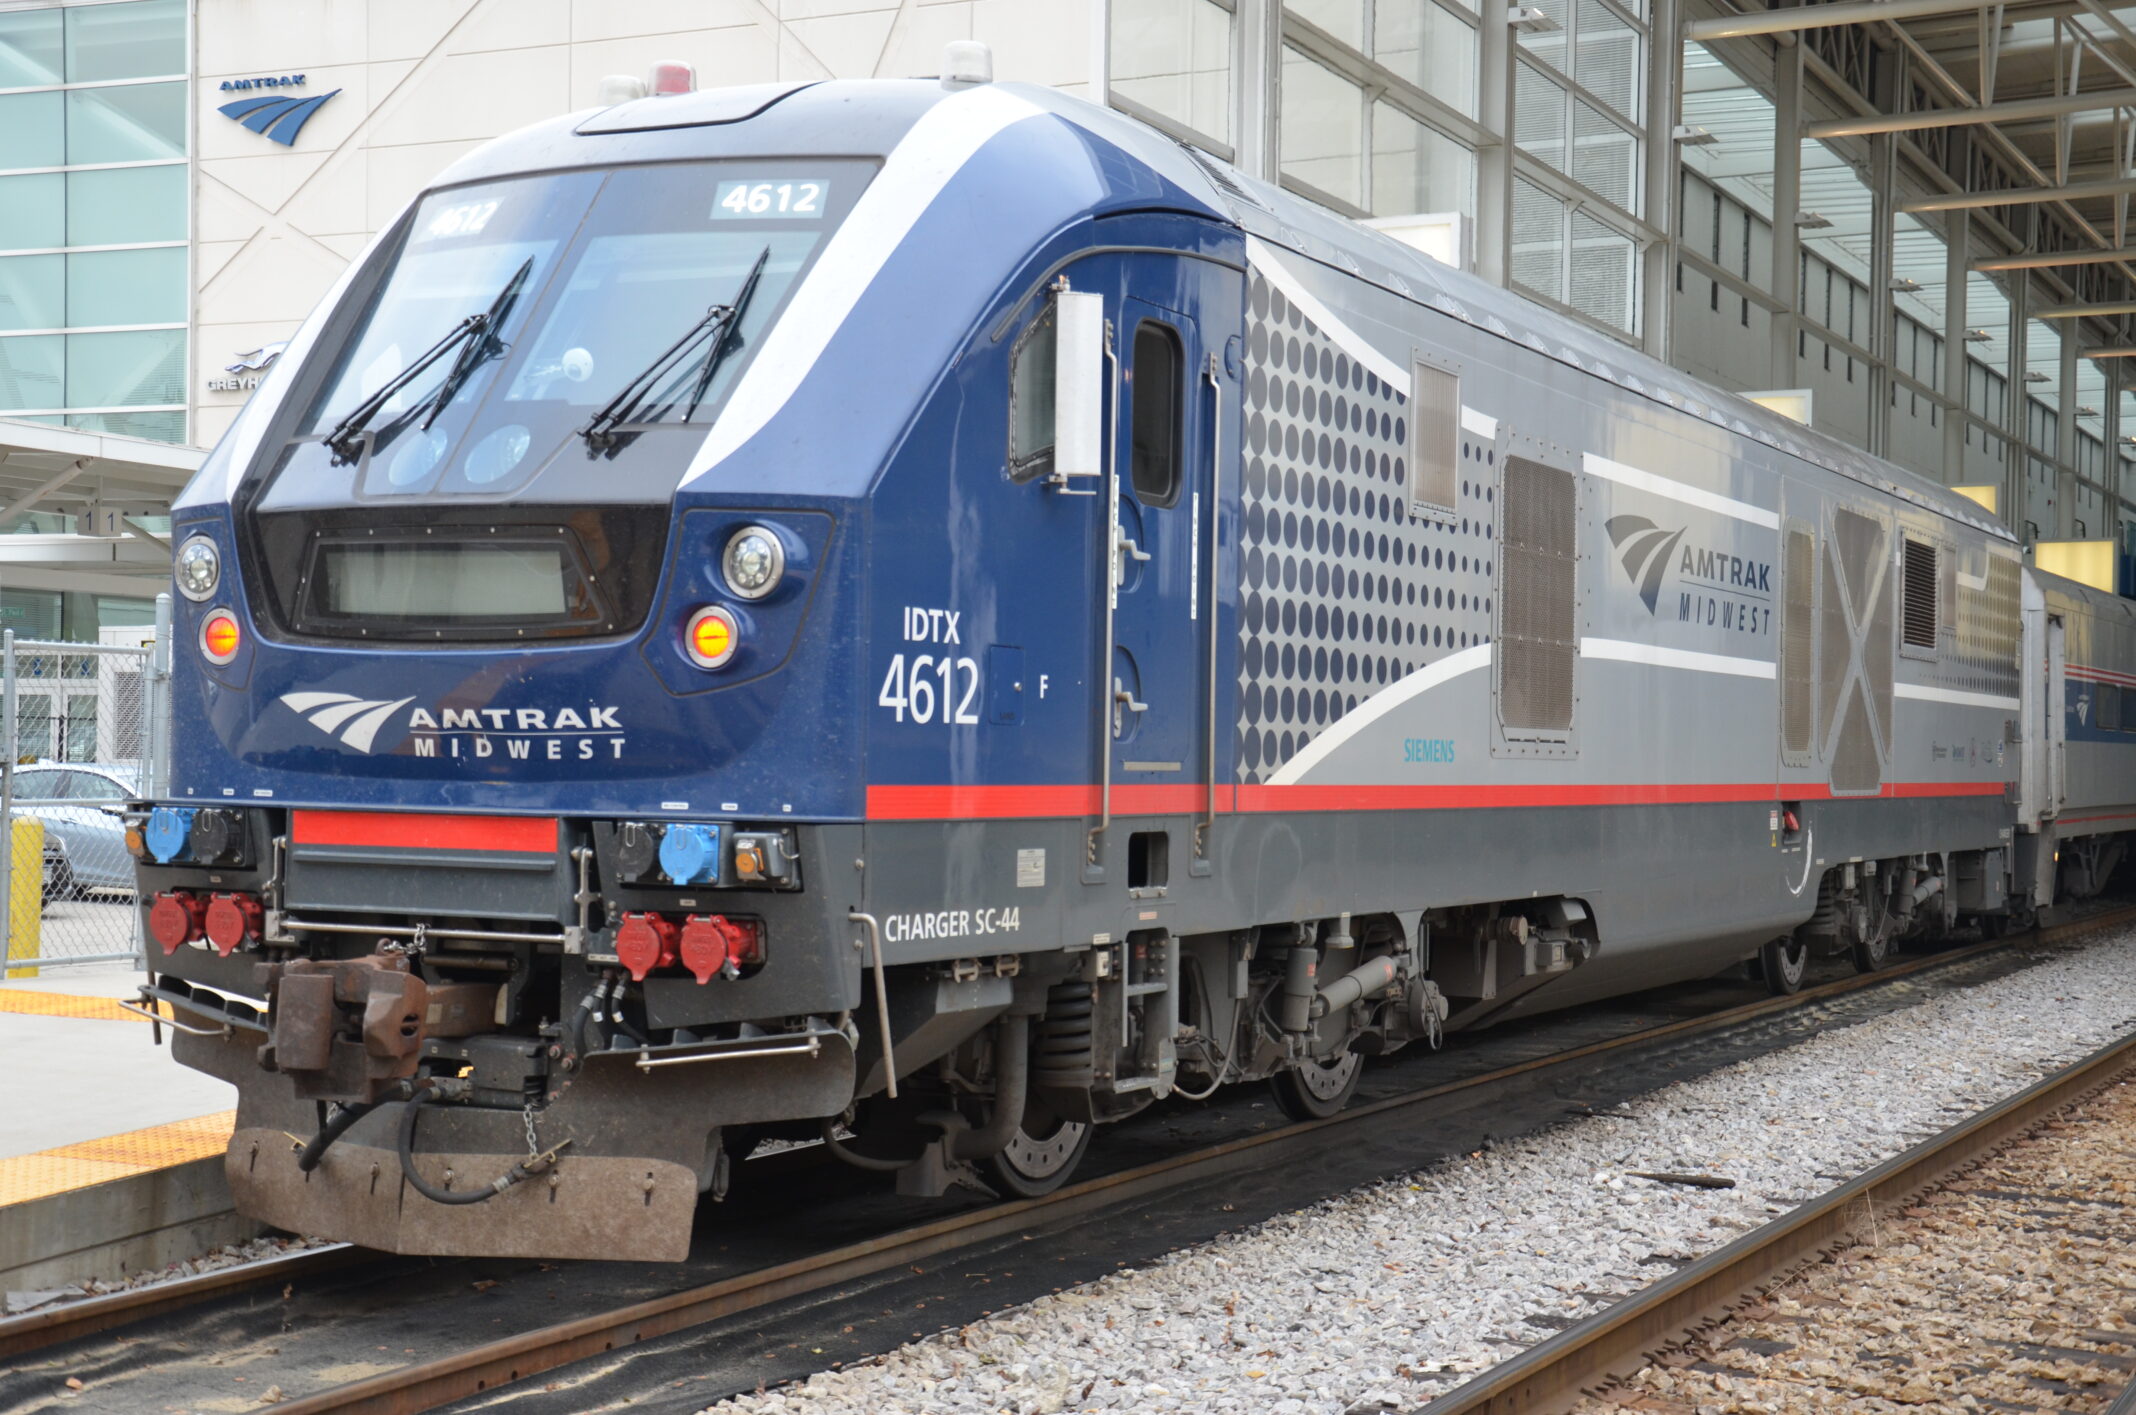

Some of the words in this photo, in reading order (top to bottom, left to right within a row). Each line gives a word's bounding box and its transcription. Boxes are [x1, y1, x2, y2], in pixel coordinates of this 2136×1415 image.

[219, 74, 305, 91] AMTRAK
[721, 183, 820, 213] 4612
[208, 377, 261, 391] GREYH
[85, 511, 92, 531] 1
[107, 511, 114, 532] 1
[1680, 544, 1771, 593] AMTRAK
[904, 606, 961, 645] IDTX
[1680, 592, 1771, 636] MIDWEST
[878, 653, 979, 724] 4612
[1040, 674, 1049, 699] F
[408, 706, 623, 730] AMTRAK
[414, 737, 626, 760] MIDWEST
[1404, 738, 1456, 763] SIEMENS
[885, 910, 970, 942] CHARGER
[975, 906, 1020, 935] SC-44
